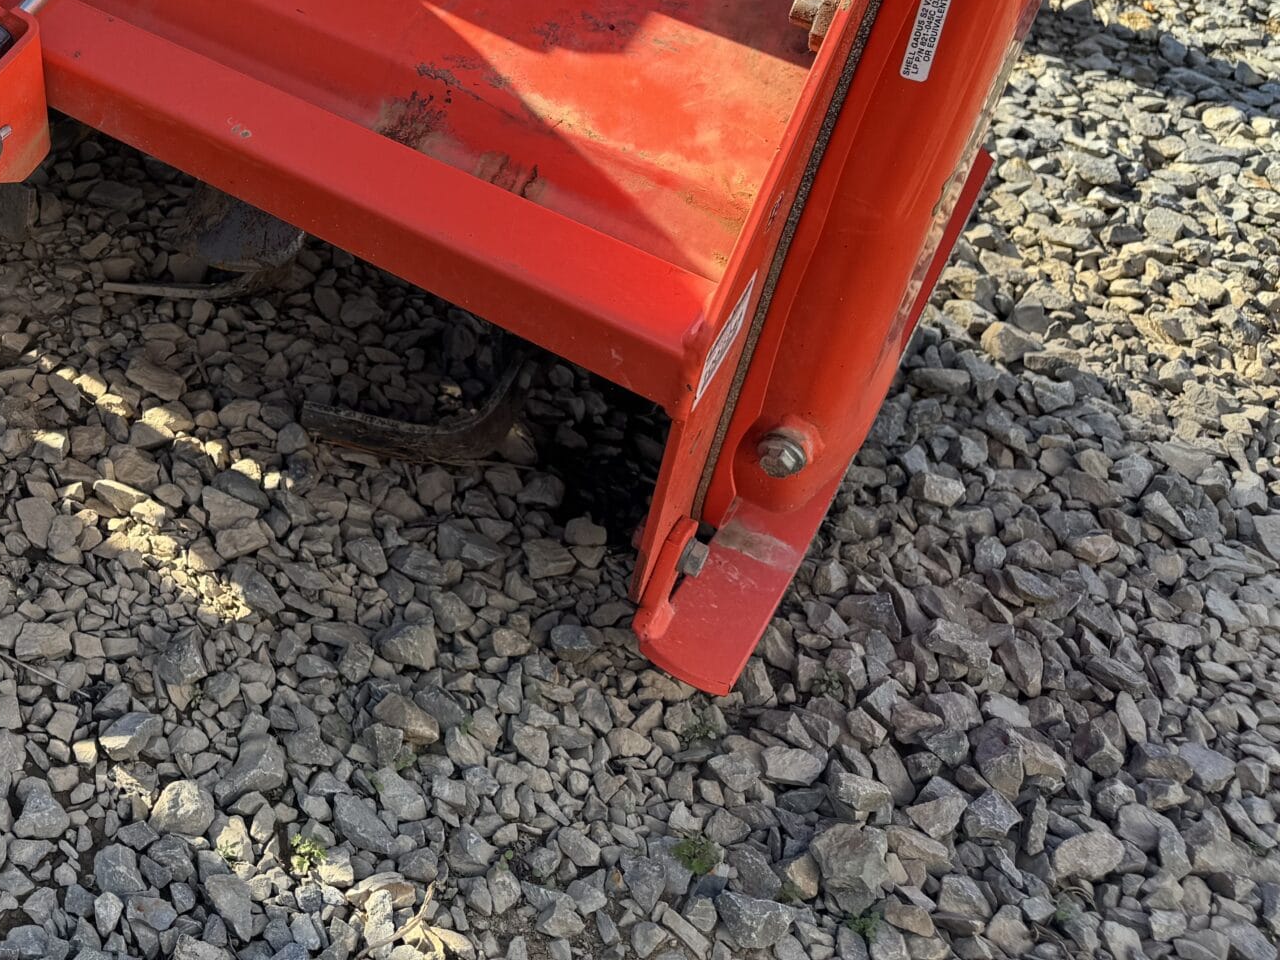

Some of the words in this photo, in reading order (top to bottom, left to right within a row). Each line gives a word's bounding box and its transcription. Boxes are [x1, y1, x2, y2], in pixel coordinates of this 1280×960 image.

[903, 51, 915, 75] SHELL
[920, 7, 928, 18] S2
[911, 64, 919, 74] LP
[916, 48, 924, 62] P/N
[920, 11, 935, 46] 821-045C
[923, 50, 932, 62] OR
